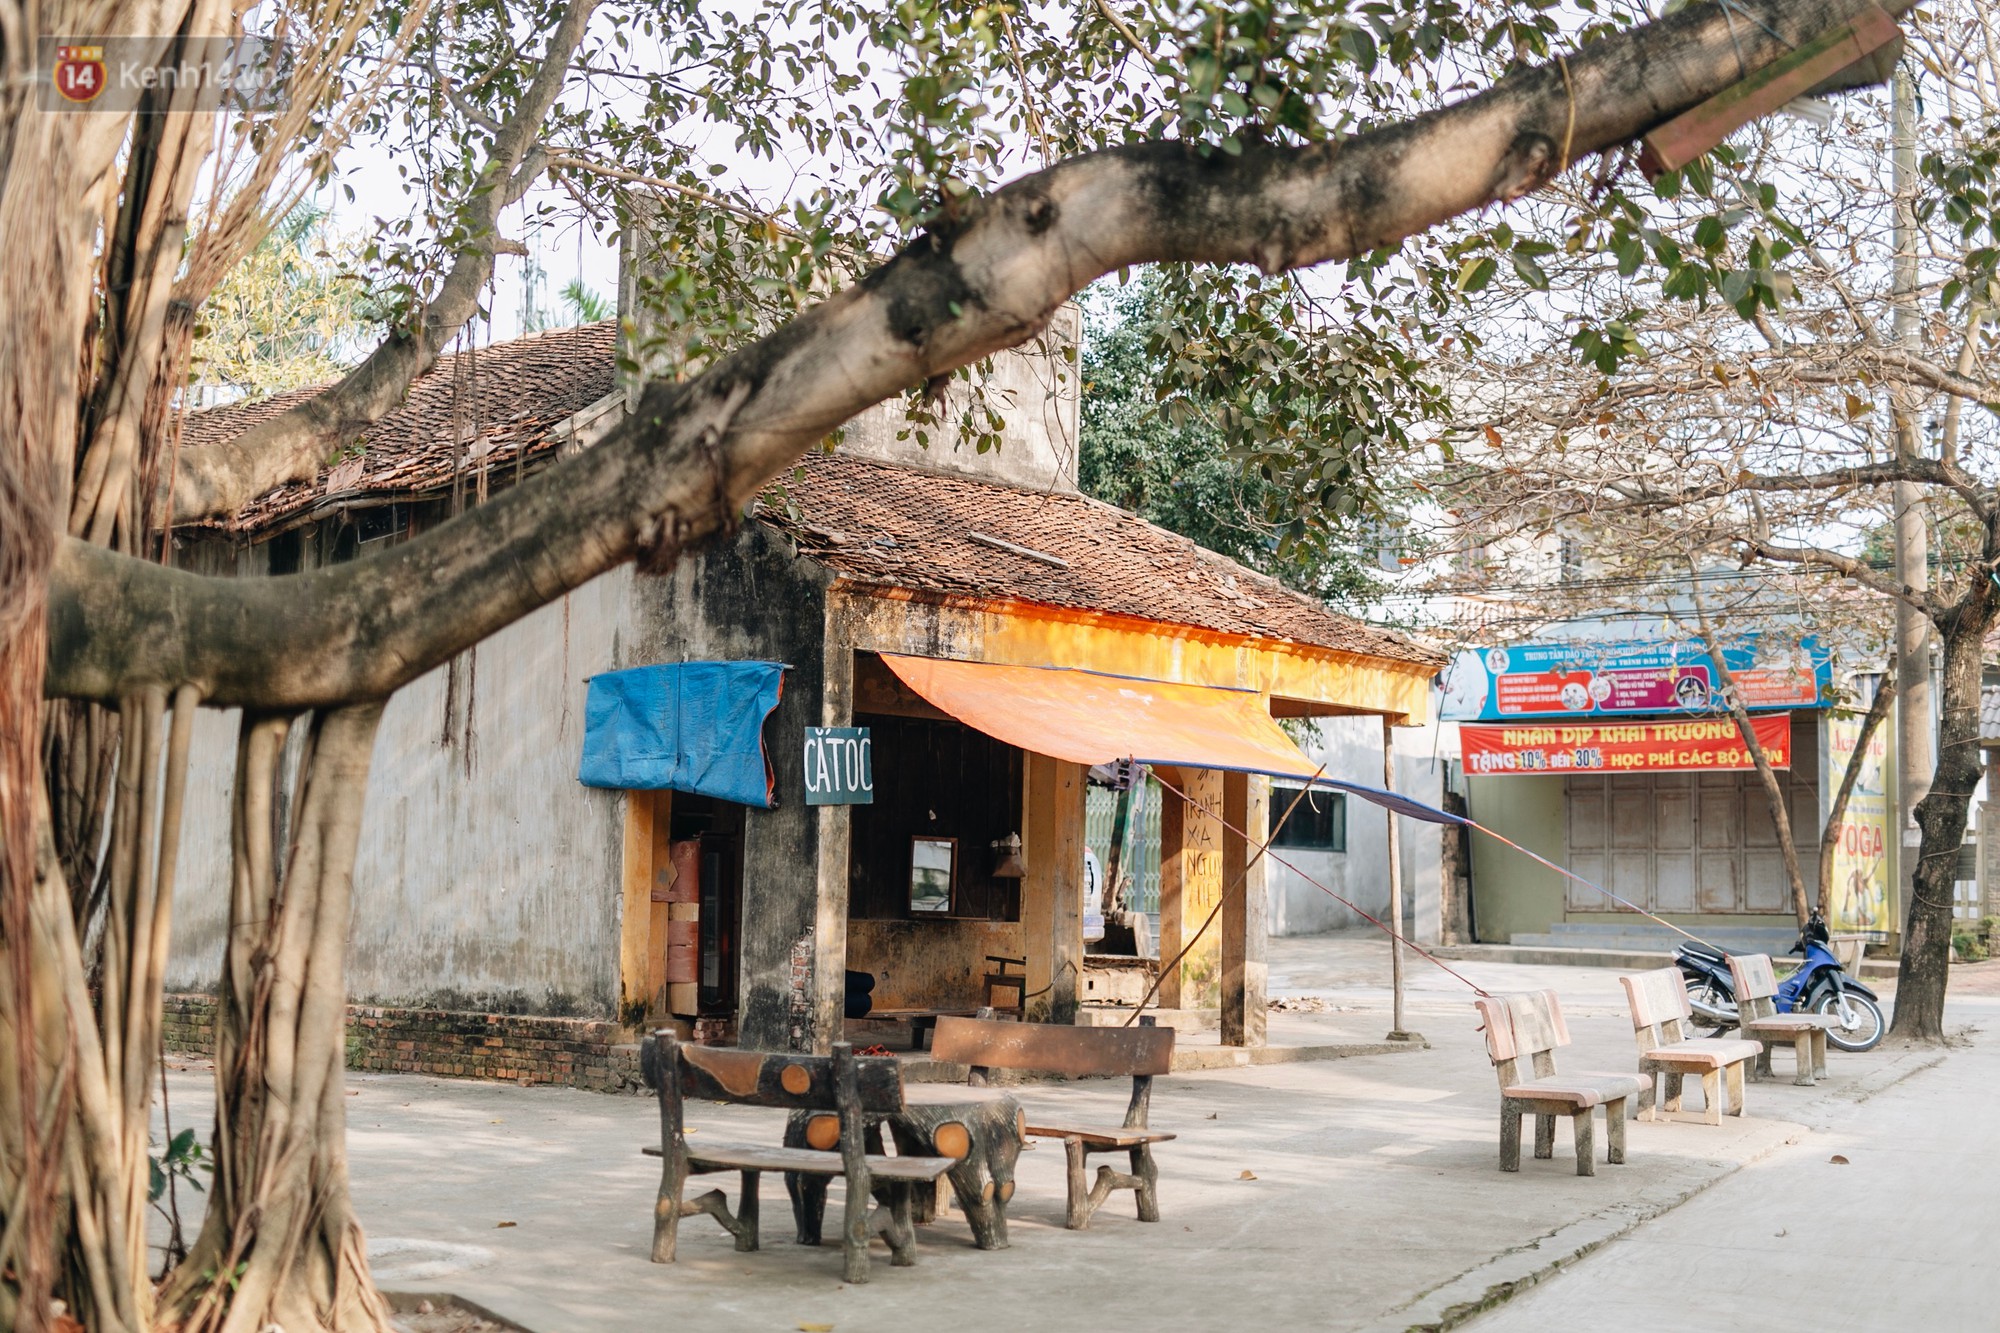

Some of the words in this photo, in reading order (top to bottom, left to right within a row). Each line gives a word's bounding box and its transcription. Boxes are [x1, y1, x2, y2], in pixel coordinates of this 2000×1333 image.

[1503, 727, 1556, 746] NHÂN
[1562, 727, 1594, 746] DỊP
[1599, 726, 1646, 744] KHAI
[1469, 750, 1516, 772] TẶNG
[1521, 750, 1547, 769] 10%
[1575, 748, 1602, 767] 30%
[1611, 752, 1644, 769] HỌC
[1648, 749, 1675, 766] PHÍ
[1678, 748, 1713, 765] CÁC
[1717, 748, 1740, 767] BỘ
